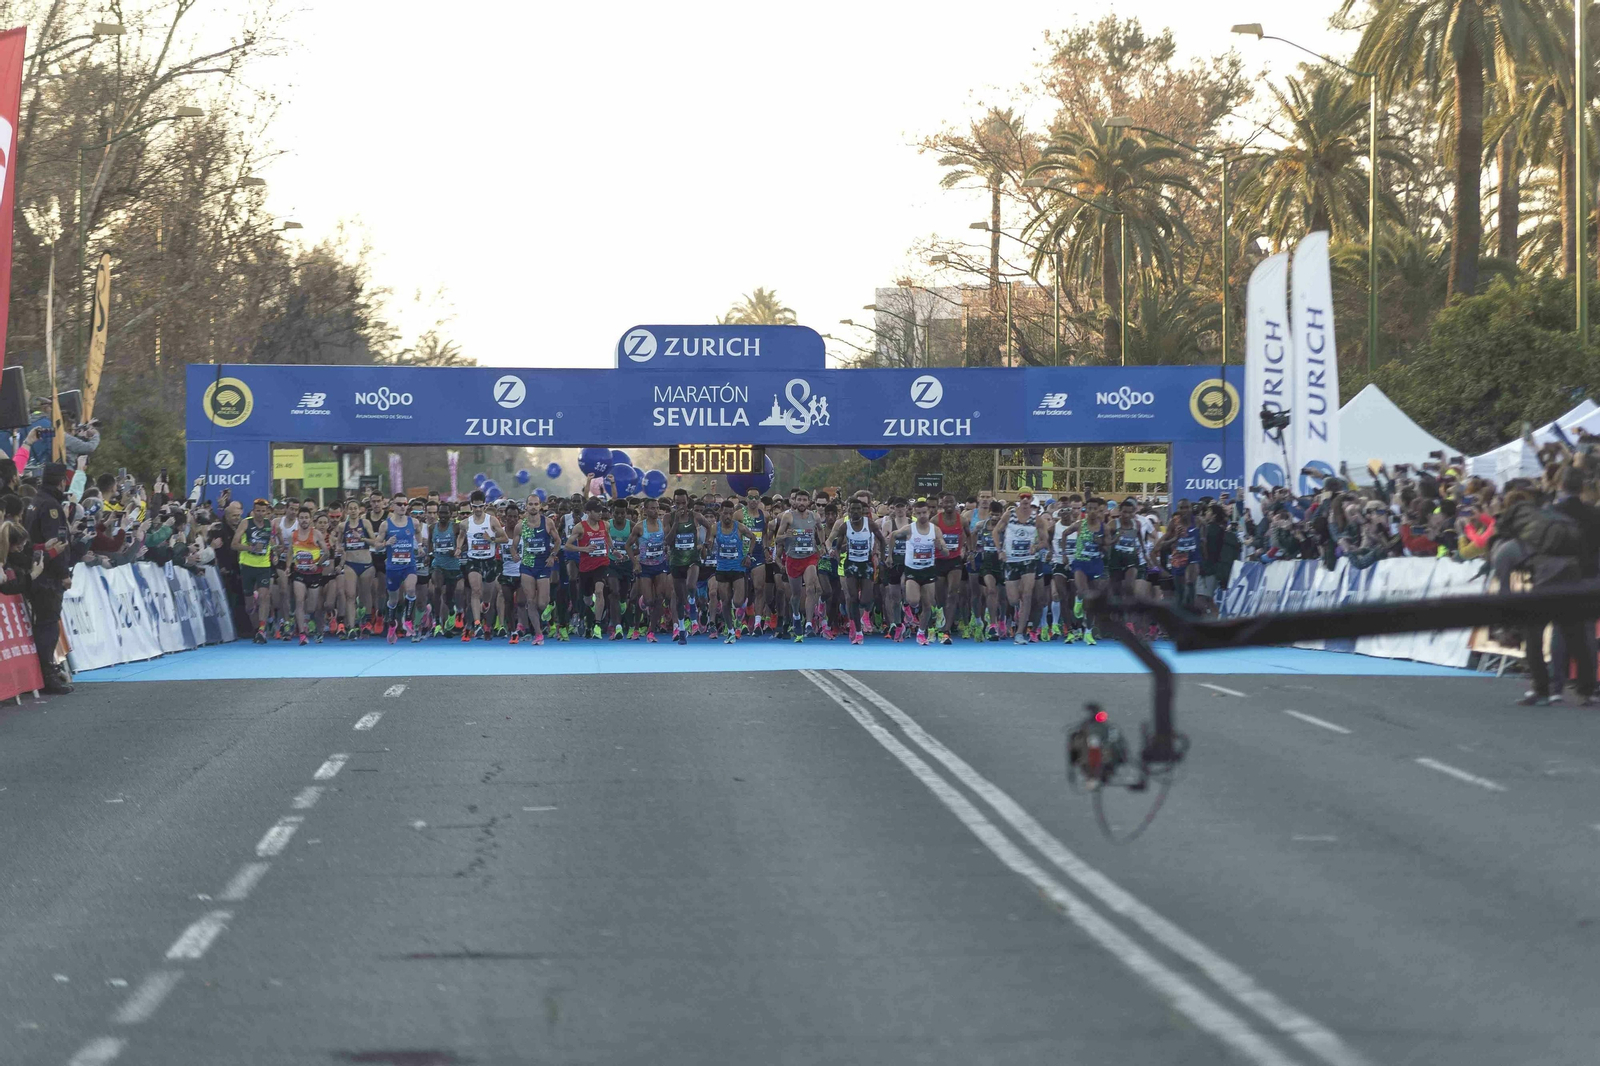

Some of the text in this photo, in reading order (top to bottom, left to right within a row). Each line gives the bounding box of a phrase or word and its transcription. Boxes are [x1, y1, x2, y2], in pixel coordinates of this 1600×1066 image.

[664, 337, 760, 357] ZURICH
[1307, 307, 1328, 443] ZURICH
[654, 382, 749, 403] MARATÓN
[465, 418, 554, 436] ZURICH
[653, 407, 750, 427] SEVILLA
[882, 418, 971, 437] ZURICH
[1185, 478, 1238, 490] ZURICH
